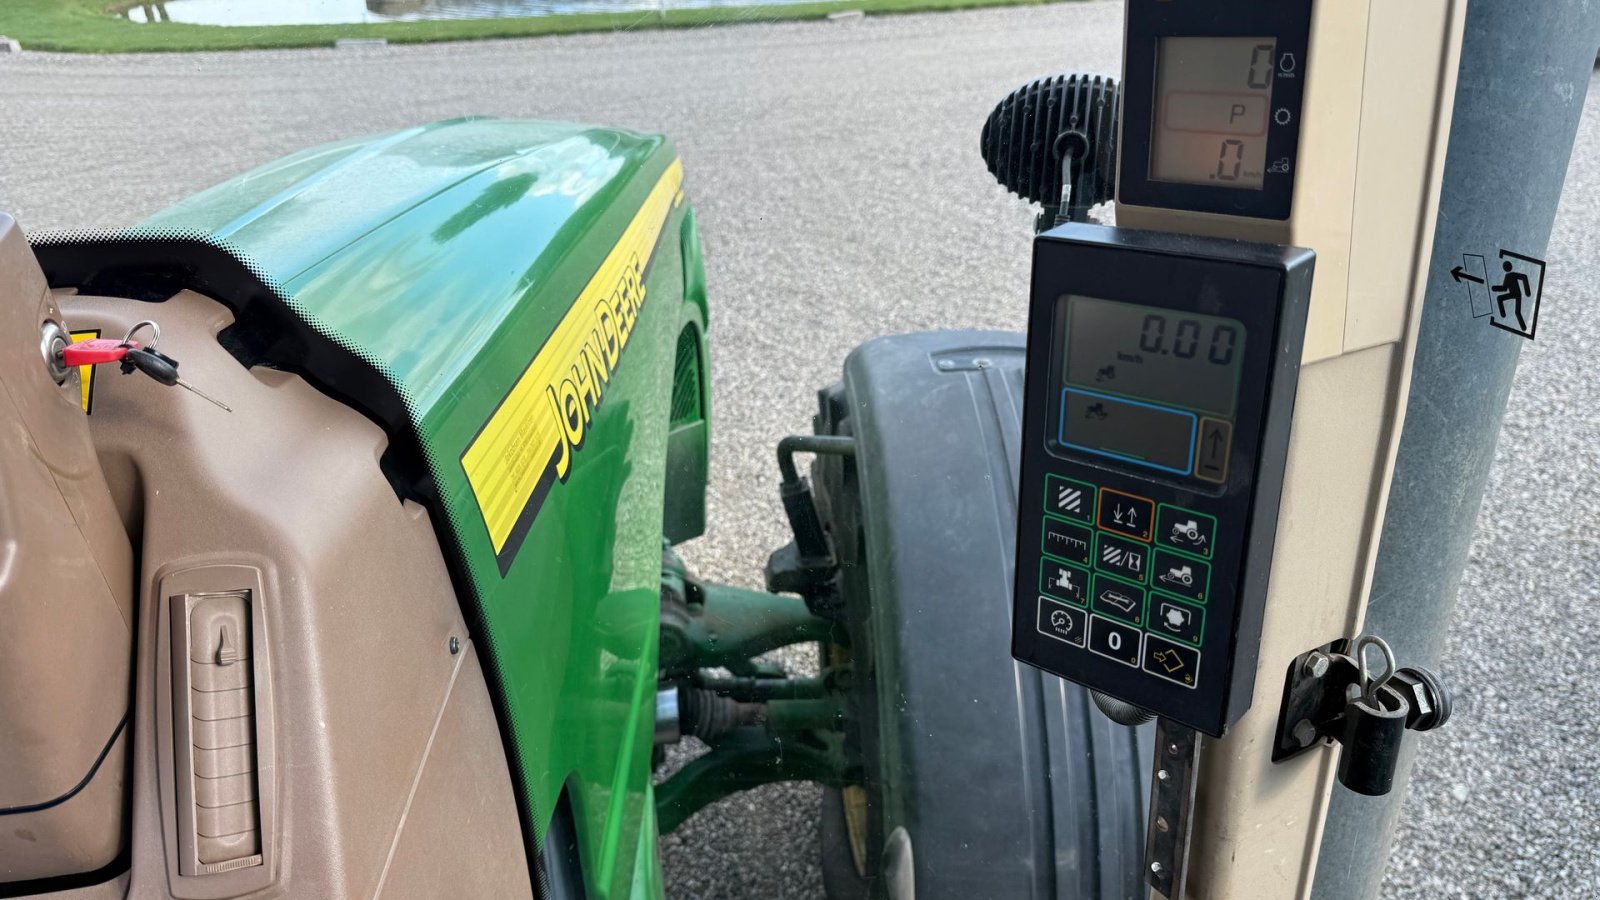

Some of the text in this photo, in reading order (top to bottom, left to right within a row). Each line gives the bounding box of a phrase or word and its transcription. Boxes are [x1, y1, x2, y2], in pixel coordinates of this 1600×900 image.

[1247, 44, 1274, 90] 0
[1229, 104, 1246, 124] P
[1139, 314, 1237, 366] 0.00
[545, 251, 647, 484] JOHN DEERE
[1107, 631, 1122, 650] 0
